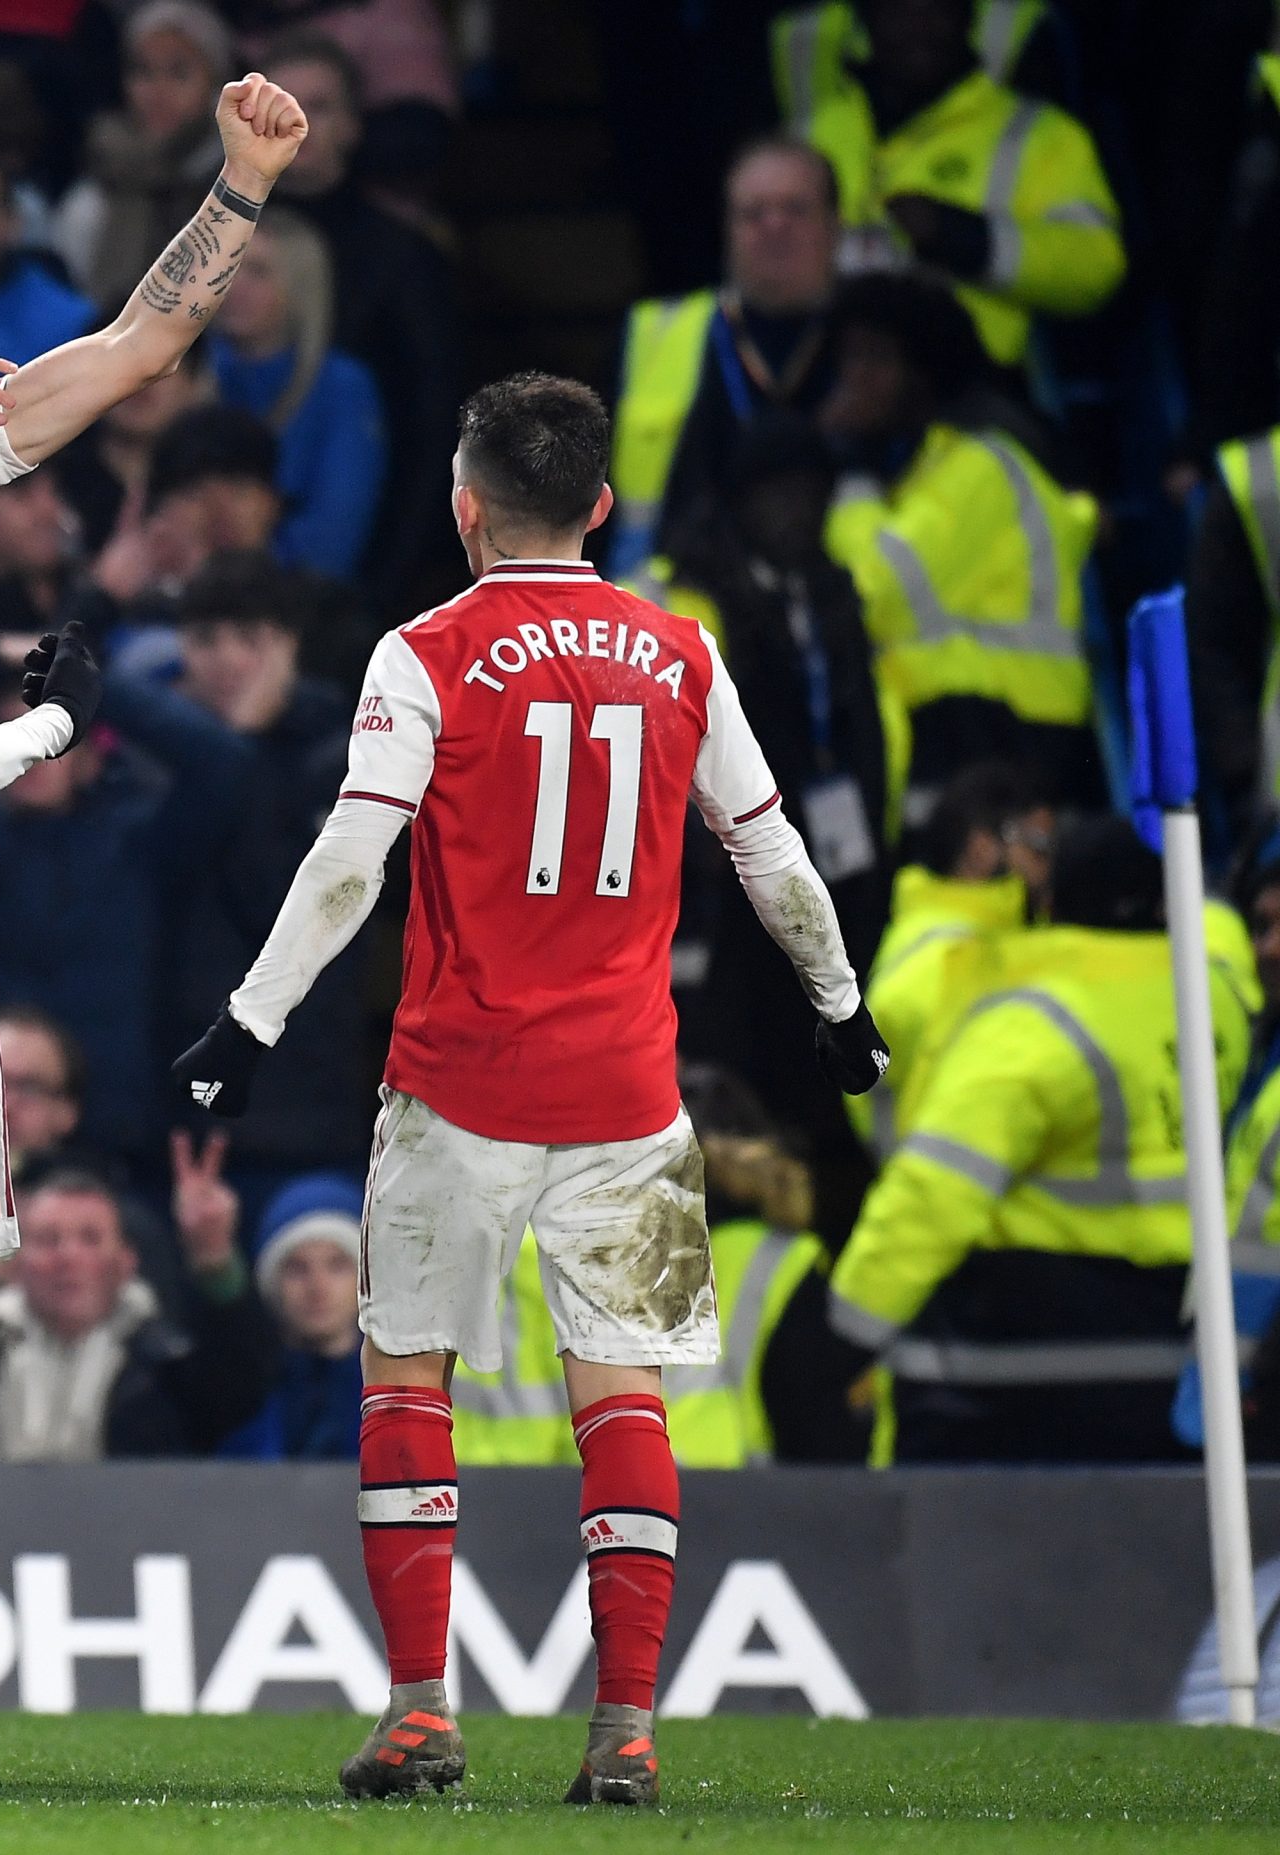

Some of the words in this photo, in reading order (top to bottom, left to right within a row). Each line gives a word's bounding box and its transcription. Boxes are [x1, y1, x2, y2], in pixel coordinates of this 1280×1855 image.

[463, 618, 686, 701] TORREIRA
[523, 701, 644, 898] 11
[411, 1506, 458, 1517] adida
